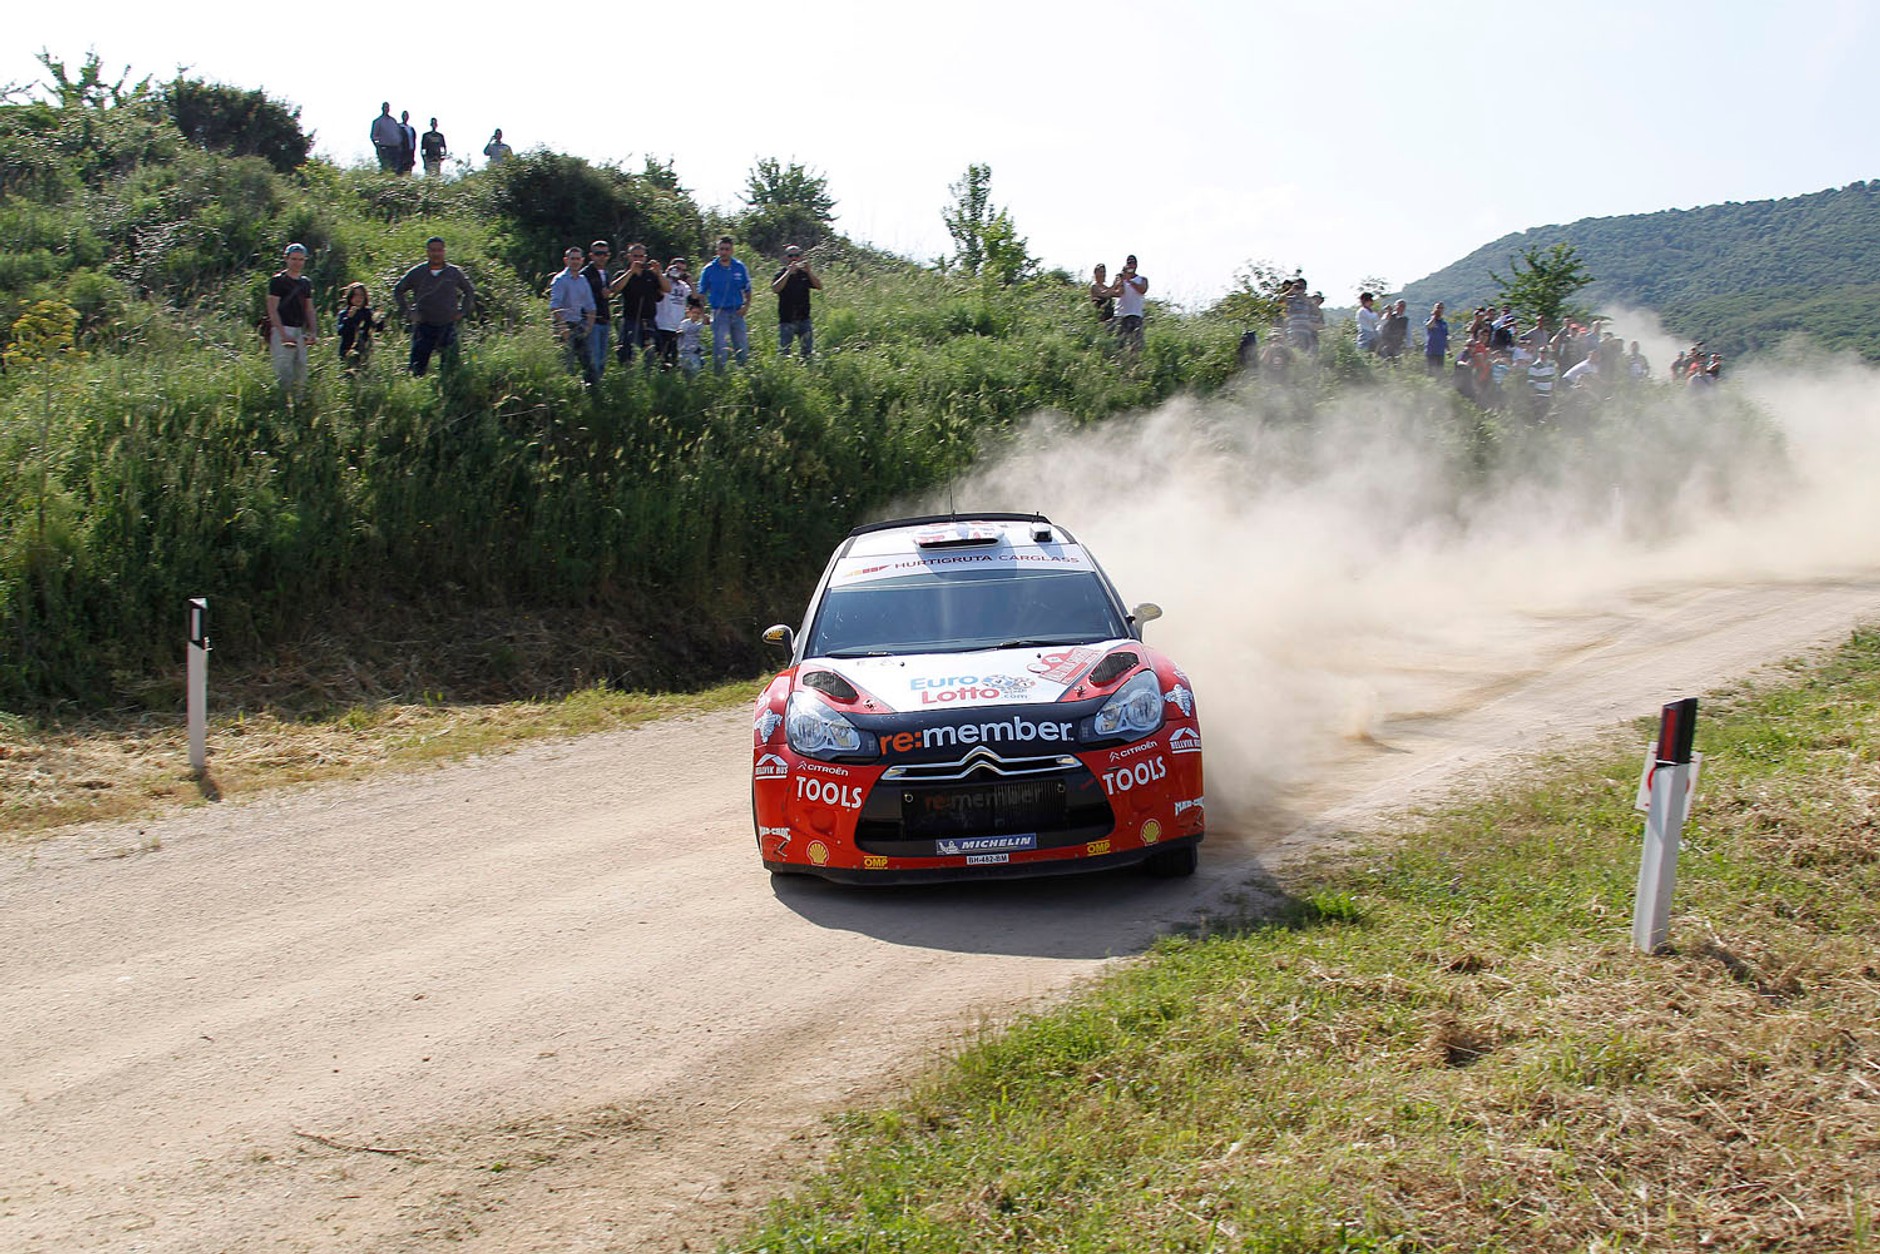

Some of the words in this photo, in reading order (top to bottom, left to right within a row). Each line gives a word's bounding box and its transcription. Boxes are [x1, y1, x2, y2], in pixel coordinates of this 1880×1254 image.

[895, 555, 993, 569] HURTIGRUTA
[998, 554, 1080, 563] CARGLASS
[910, 676, 979, 690] Euro
[922, 687, 1000, 704] Lotto
[880, 716, 1073, 756] re:member
[1102, 756, 1166, 795] TOOLS
[796, 776, 862, 809] TOOLS
[962, 836, 1032, 850] MICHELIN
[1087, 842, 1111, 853] OMP
[864, 857, 888, 867] OMP
